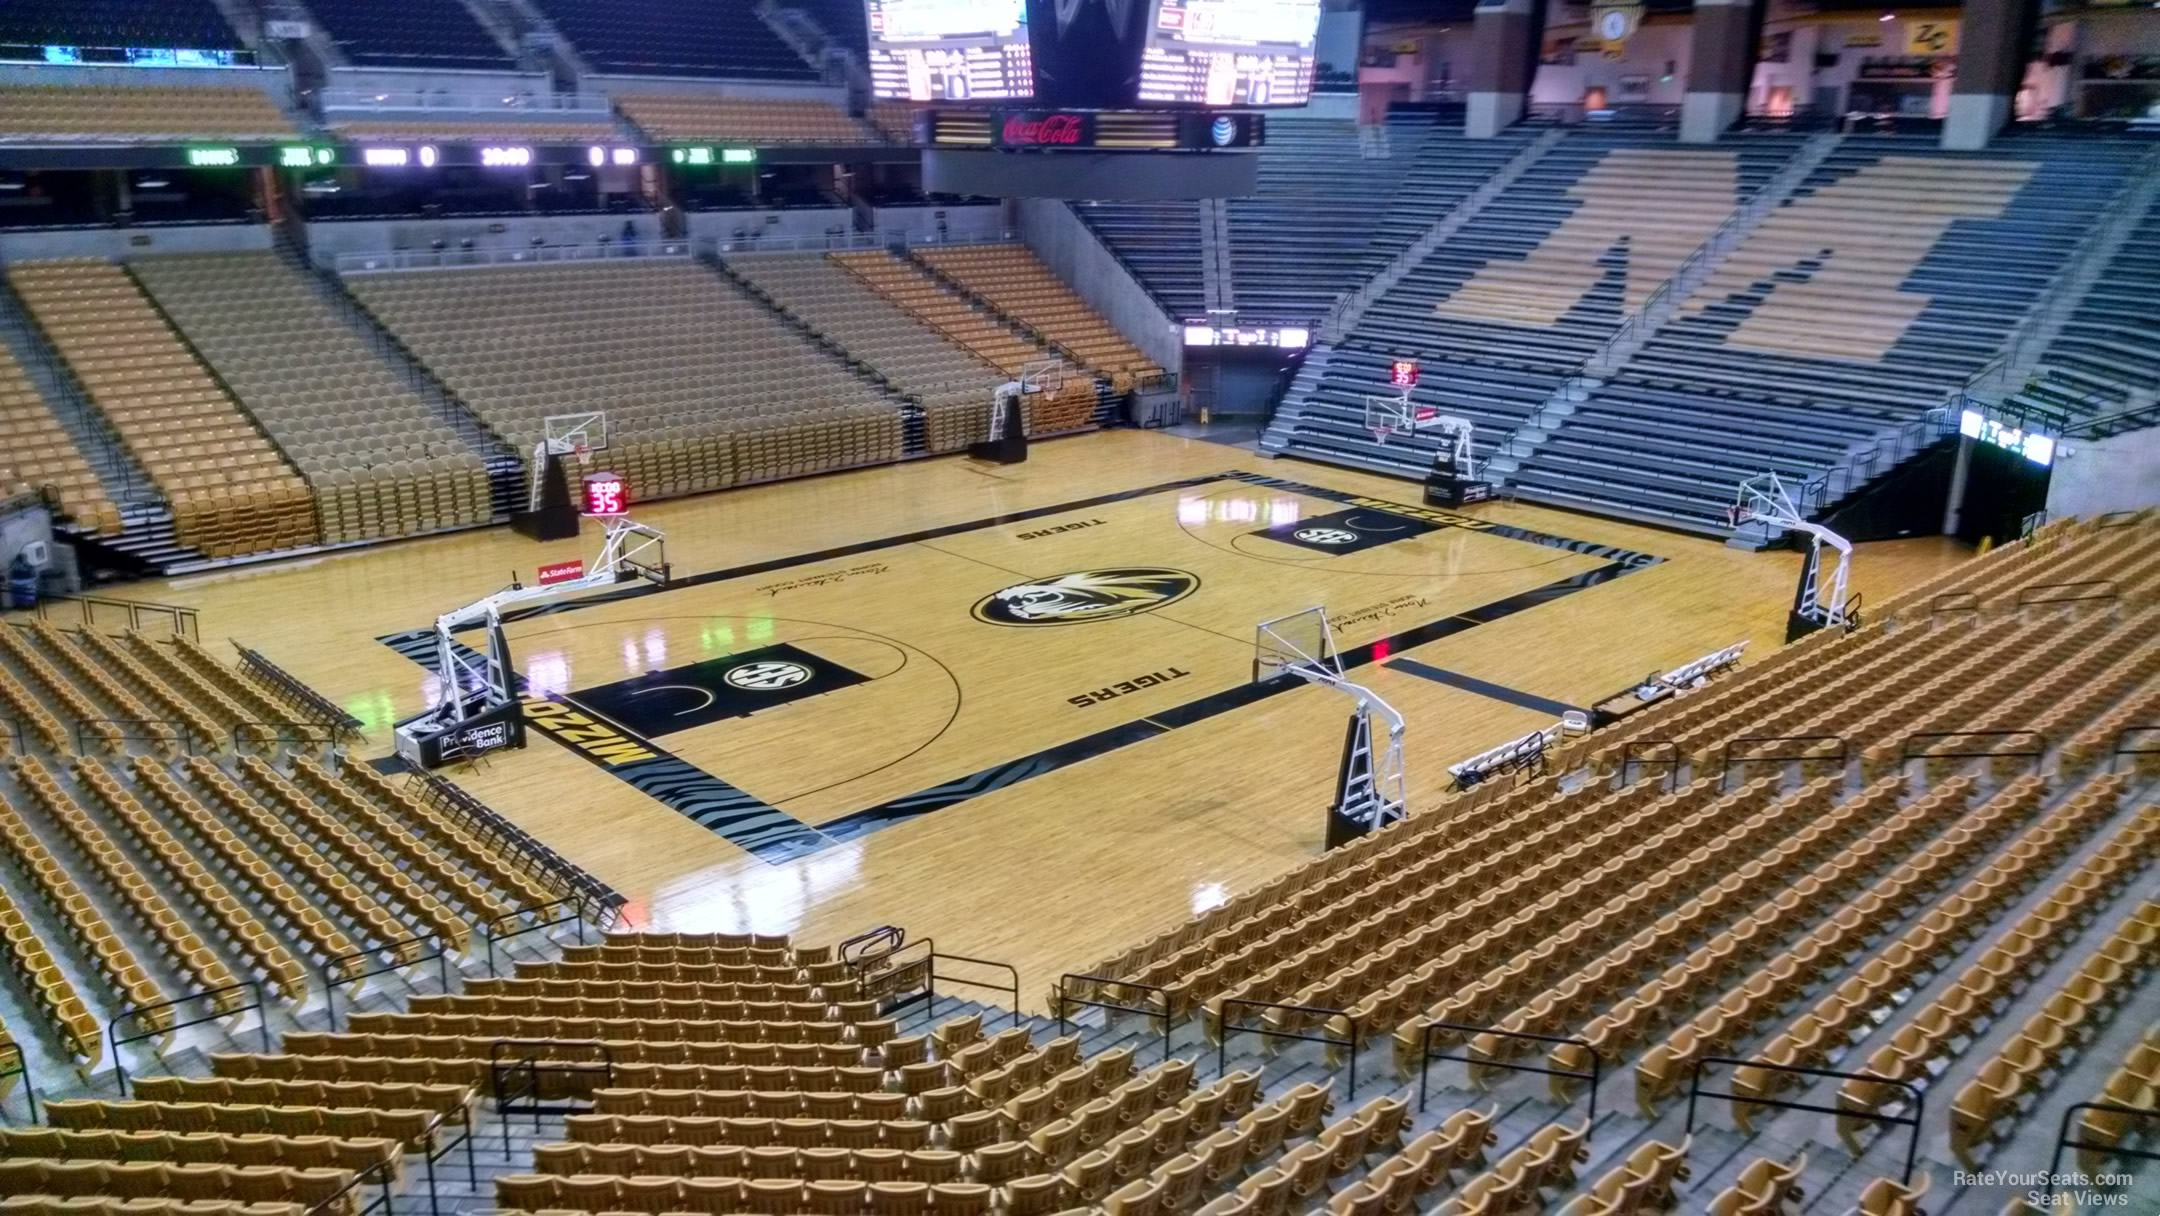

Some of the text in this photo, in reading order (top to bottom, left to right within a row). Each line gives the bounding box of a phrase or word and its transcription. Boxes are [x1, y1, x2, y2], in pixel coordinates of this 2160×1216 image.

[1003, 114, 1082, 144] Coca-Cola
[591, 481, 620, 494] 10:00
[592, 492, 618, 513] 35
[1345, 497, 1498, 530] MIZZOU
[1016, 518, 1107, 541] TIGERS
[1297, 526, 1354, 544] SEC
[729, 662, 807, 688] SEC
[1066, 667, 1191, 709] TIGERS
[475, 735, 503, 749] Bank
